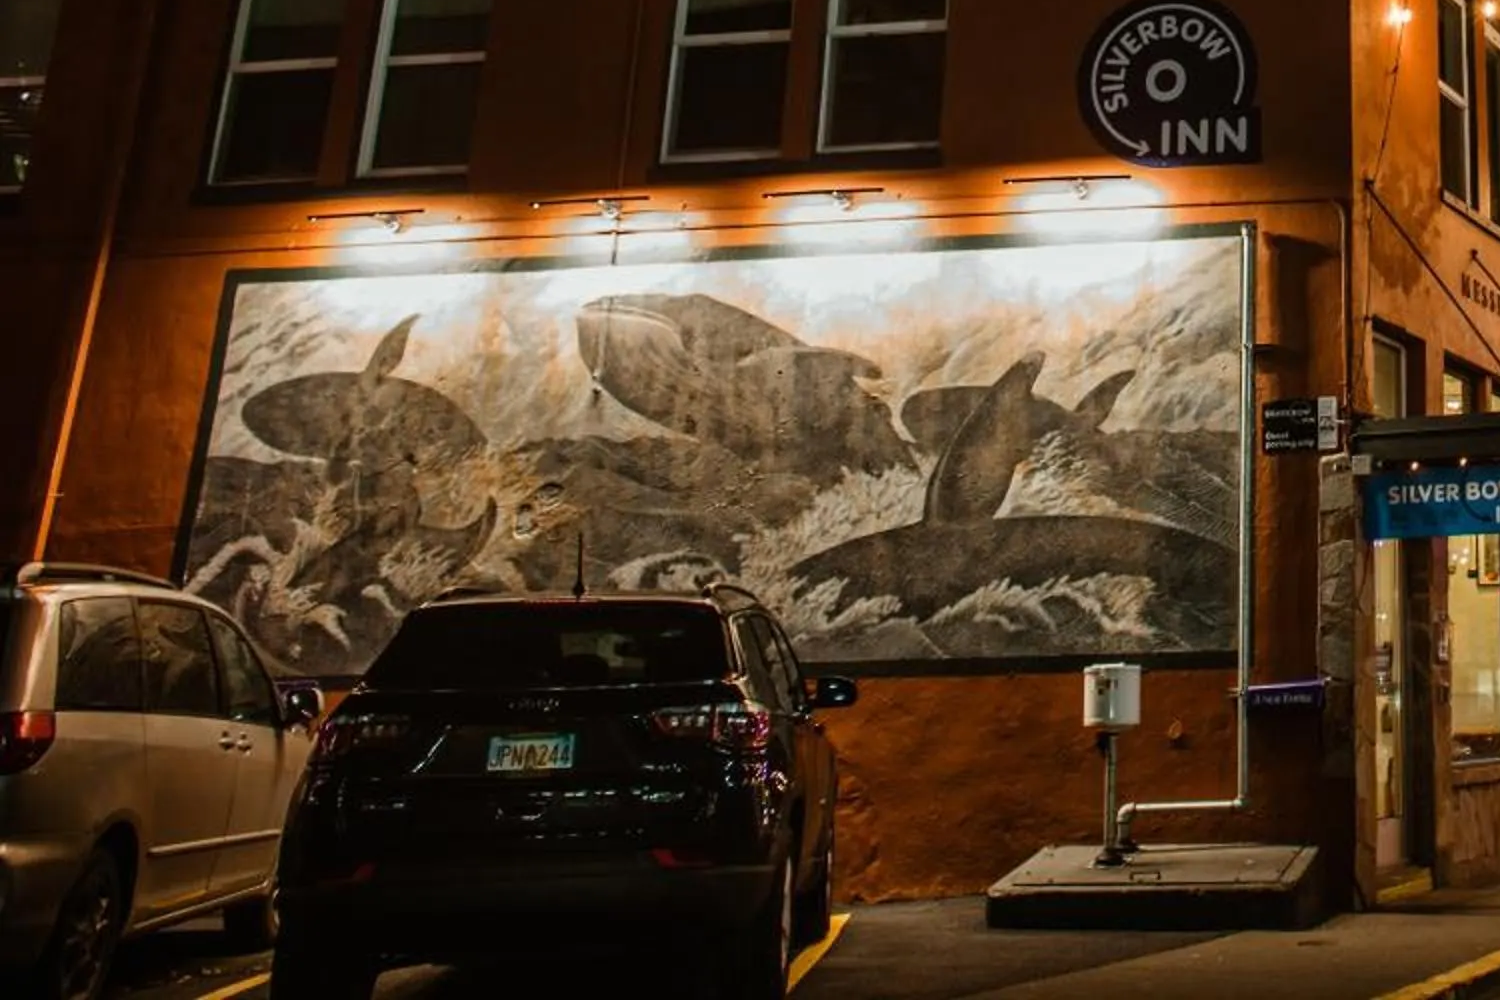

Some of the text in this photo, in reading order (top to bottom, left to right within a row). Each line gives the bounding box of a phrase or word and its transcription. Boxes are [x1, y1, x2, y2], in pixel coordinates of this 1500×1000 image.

[1100, 15, 1231, 113] SILVERBOW
[1161, 116, 1247, 156] INN
[1388, 483, 1460, 505] SILVER
